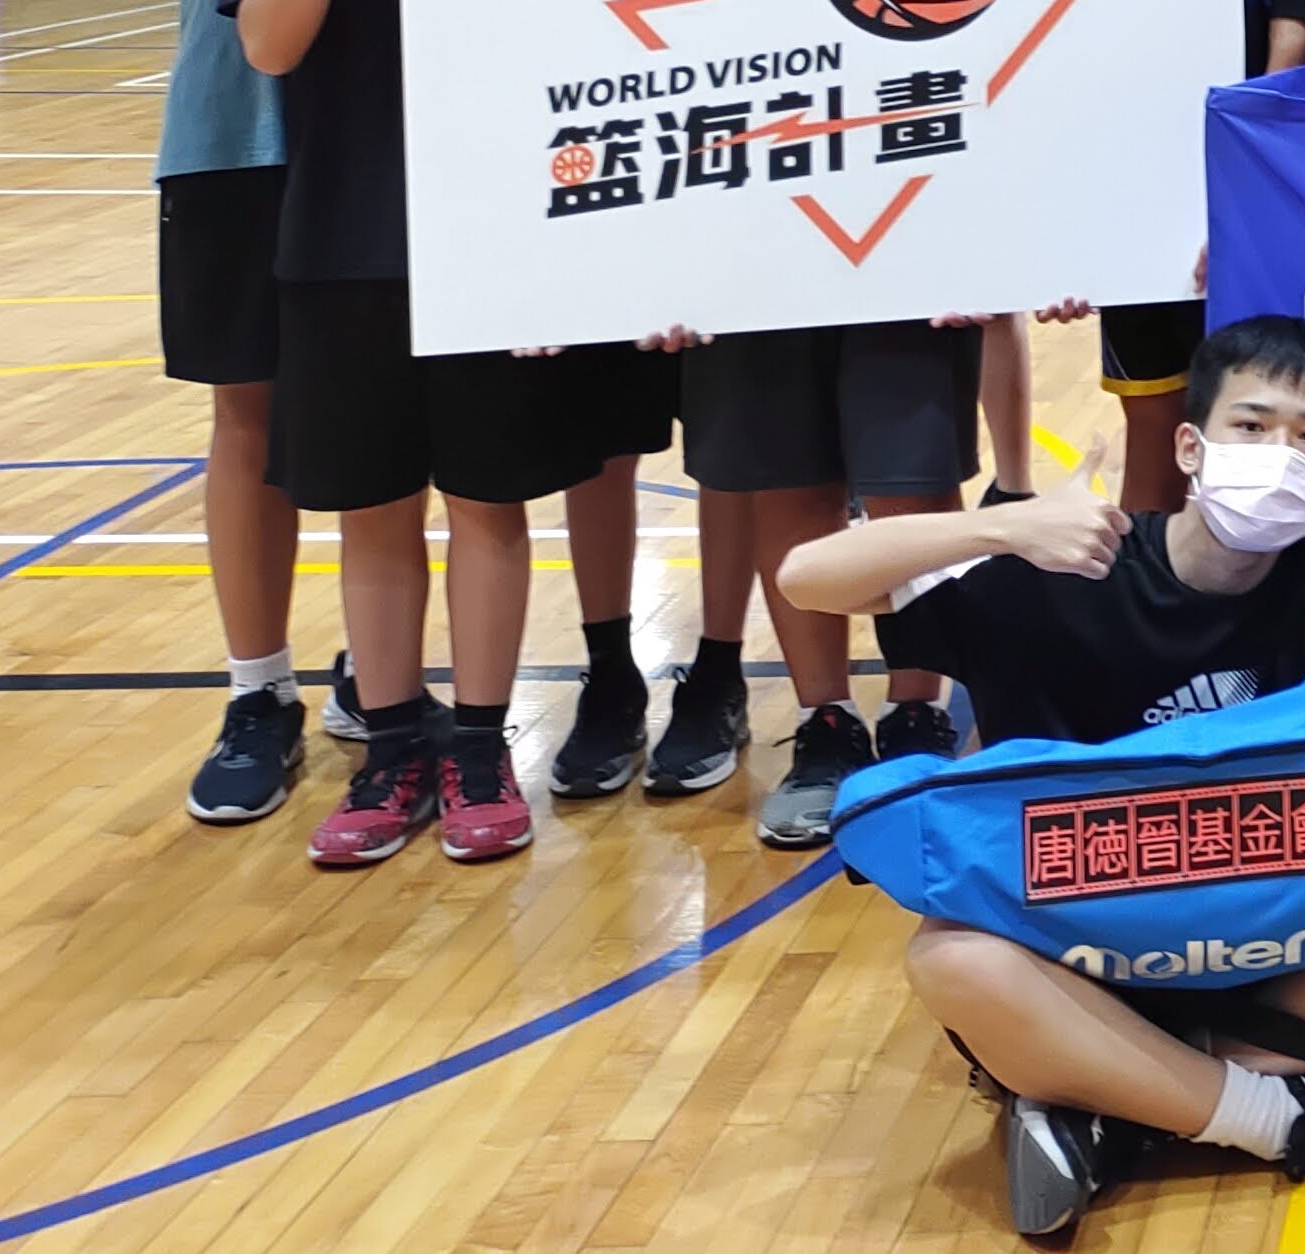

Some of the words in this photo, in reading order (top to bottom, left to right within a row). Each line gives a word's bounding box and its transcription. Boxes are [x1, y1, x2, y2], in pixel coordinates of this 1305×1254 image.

[547, 65, 695, 113] WORLD
[706, 42, 843, 89] VISION
[547, 69, 969, 219] 籃海計畫
